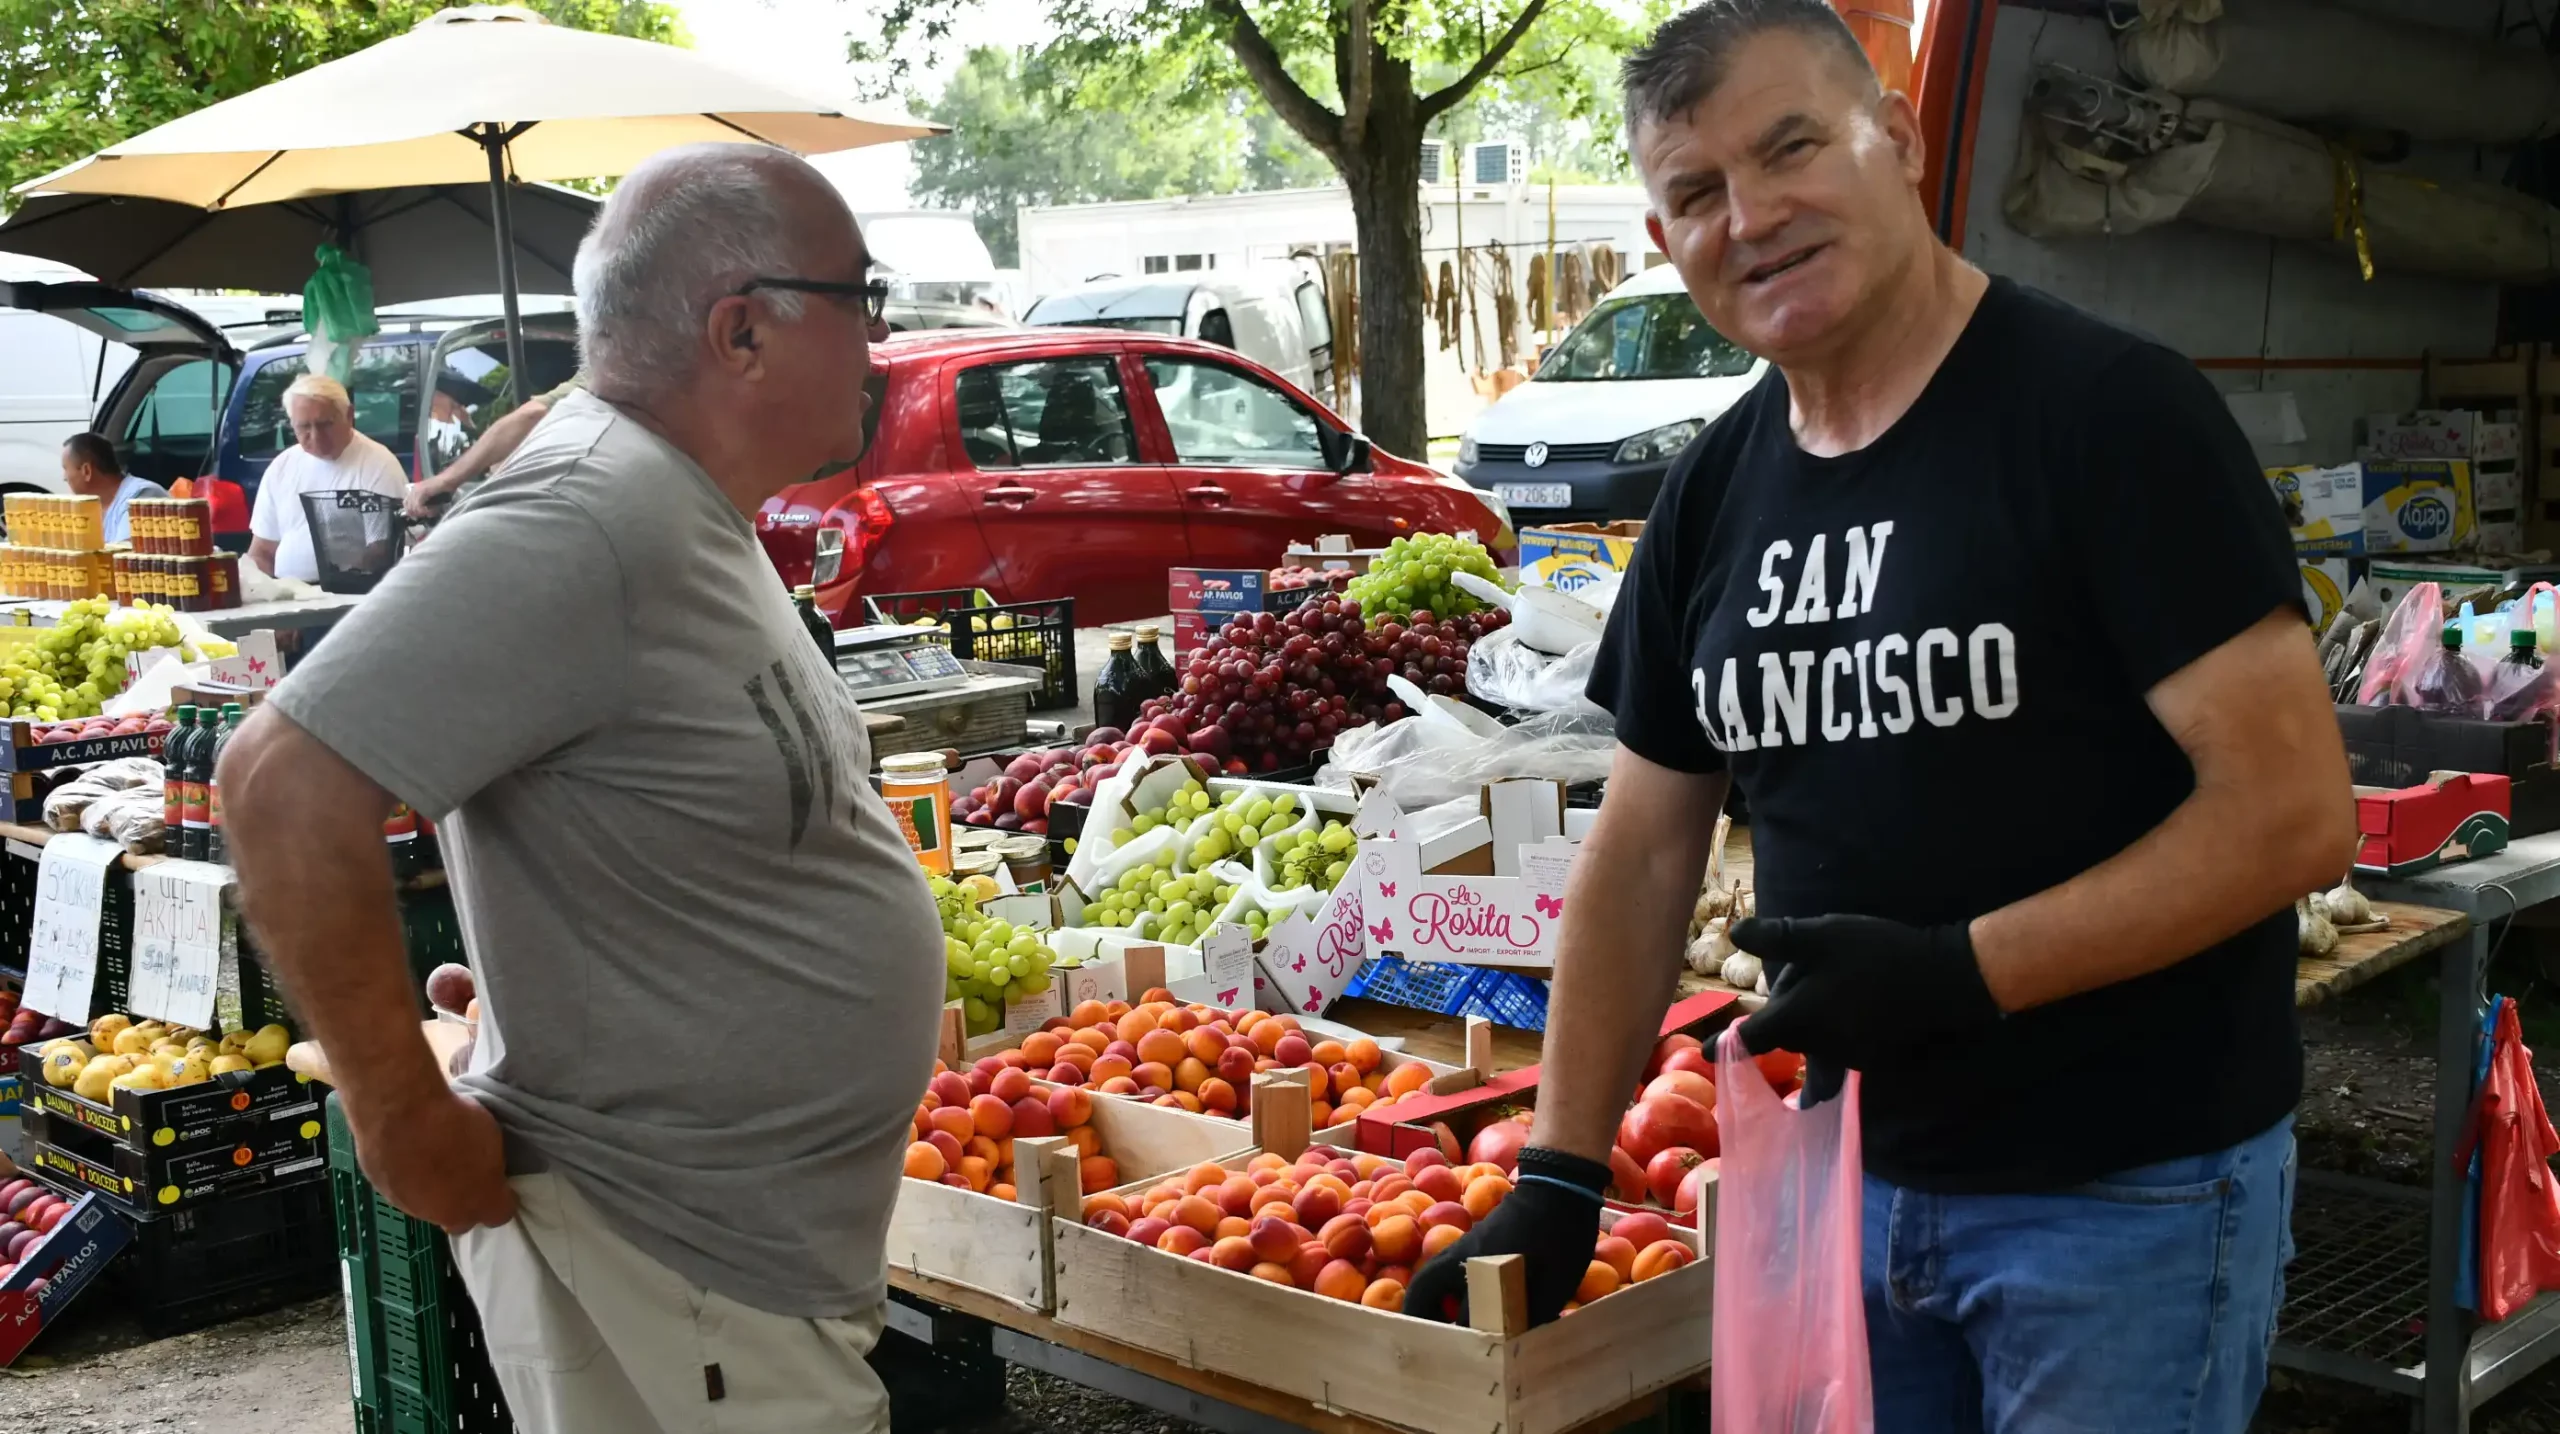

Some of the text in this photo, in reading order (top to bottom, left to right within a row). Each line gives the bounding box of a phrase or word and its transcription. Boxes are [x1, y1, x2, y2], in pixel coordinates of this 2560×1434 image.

[1746, 520, 1894, 628] SAN
[1188, 590, 1243, 600] A.C. AP. PAVLOS
[1692, 623, 2019, 752] RANCISCO
[51, 735, 165, 761] A.C. AP. PAVLOS
[1448, 884, 1481, 906] La
[1409, 893, 1540, 953] Rosita
[1317, 898, 1364, 978] Rosi
[1496, 948, 1521, 956] EXPORT
[46, 1092, 75, 1116] DAUNIA
[190, 1126, 211, 1137] APOC
[48, 1151, 77, 1175] DAUNIA
[194, 1183, 215, 1194] APOC
[15, 1302, 38, 1326] A.C.
[37, 1282, 57, 1303] AP.
[54, 1239, 98, 1285] PAVLOS
